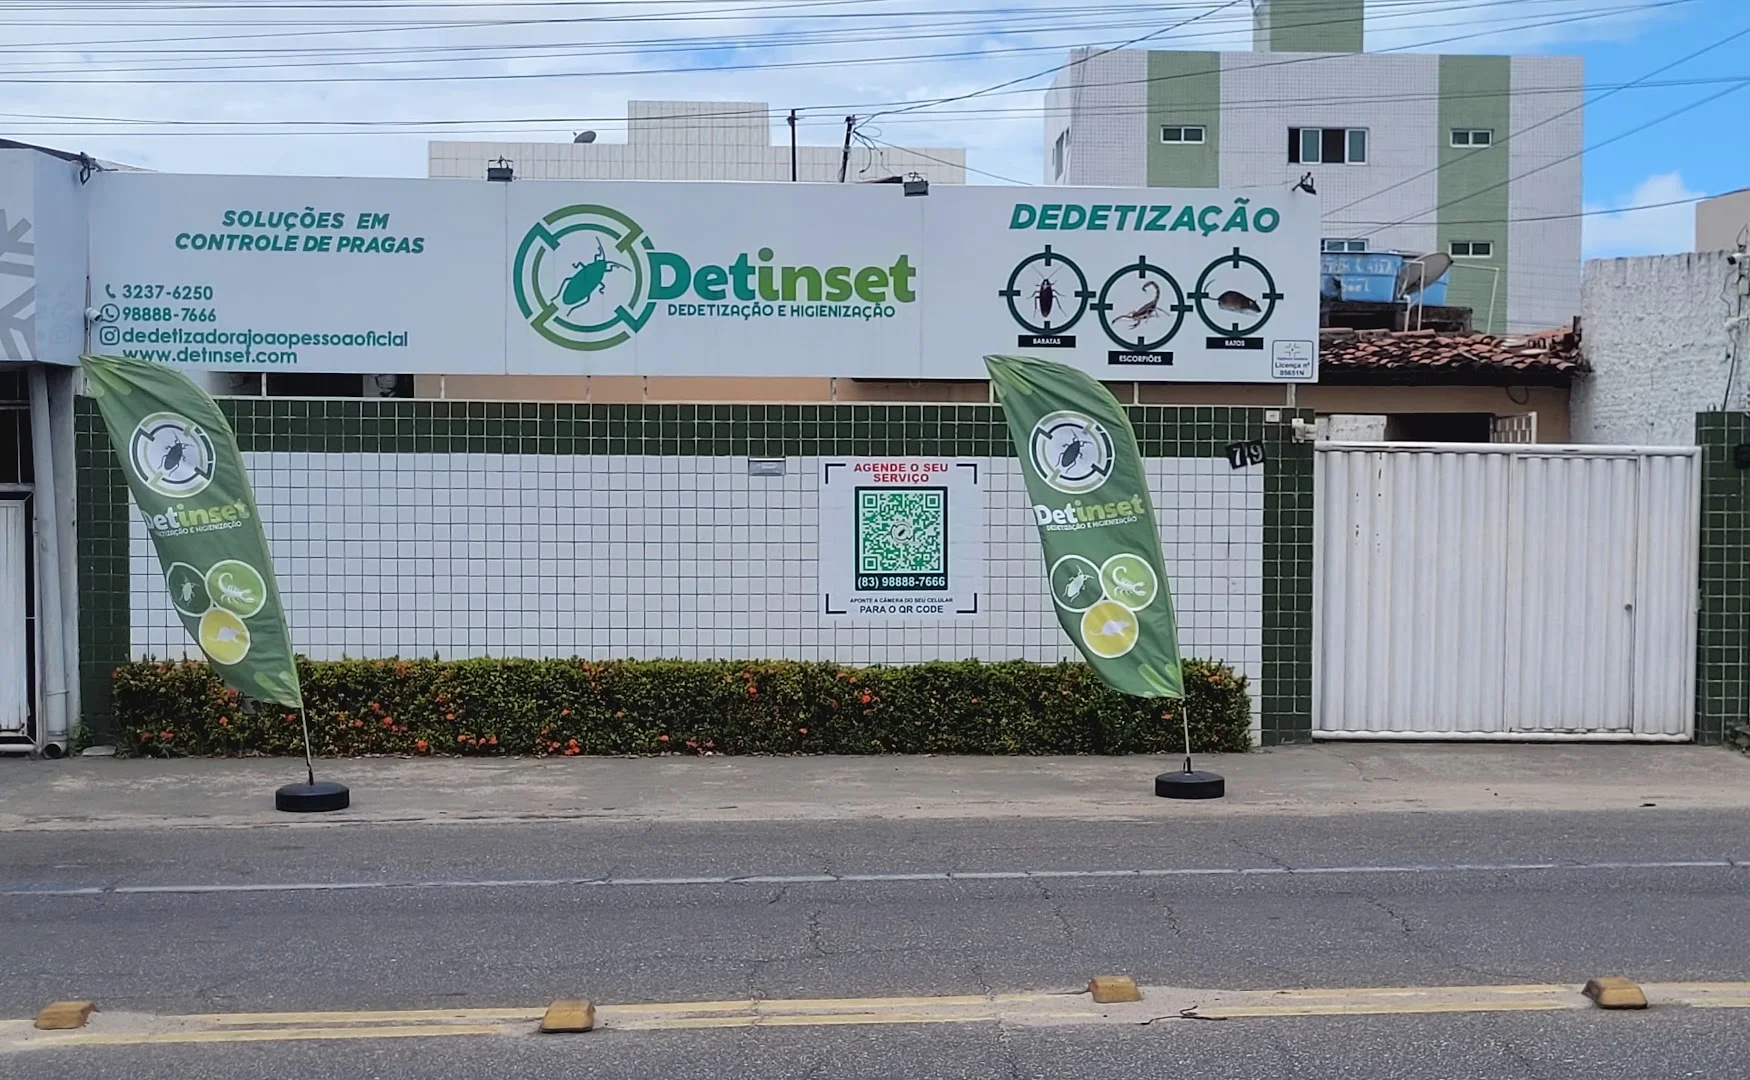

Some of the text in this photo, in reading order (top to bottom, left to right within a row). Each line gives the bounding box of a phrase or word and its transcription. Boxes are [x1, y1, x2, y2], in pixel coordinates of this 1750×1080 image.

[222, 206, 390, 231] SOLUÇÕES EM
[1009, 197, 1280, 237] DEDETIZAÇÃO
[175, 233, 425, 254] CONTROLE DE PRAGAS
[647, 247, 916, 304] Detinset
[122, 284, 214, 301] 3237-6250
[122, 306, 217, 323] 98888-7666
[668, 303, 896, 322] DEDETIZAÇÃO E HIGIENIZAÇÃO
[122, 328, 408, 349] dedetizadorajoaopessoaoficial
[1032, 337, 1062, 346] BARATAS
[1224, 339, 1246, 347] RATOS
[122, 346, 298, 364] www.detinset.com
[1118, 353, 1163, 364] ESCORPIÕES
[1232, 444, 1263, 467] 79
[854, 463, 948, 472] AGENDE O SEU
[873, 473, 929, 484] SERVIÇO
[1032, 493, 1145, 526] Detinset
[858, 576, 946, 589] (83) 98888-7666
[860, 605, 944, 613] PARA O QR CODE
